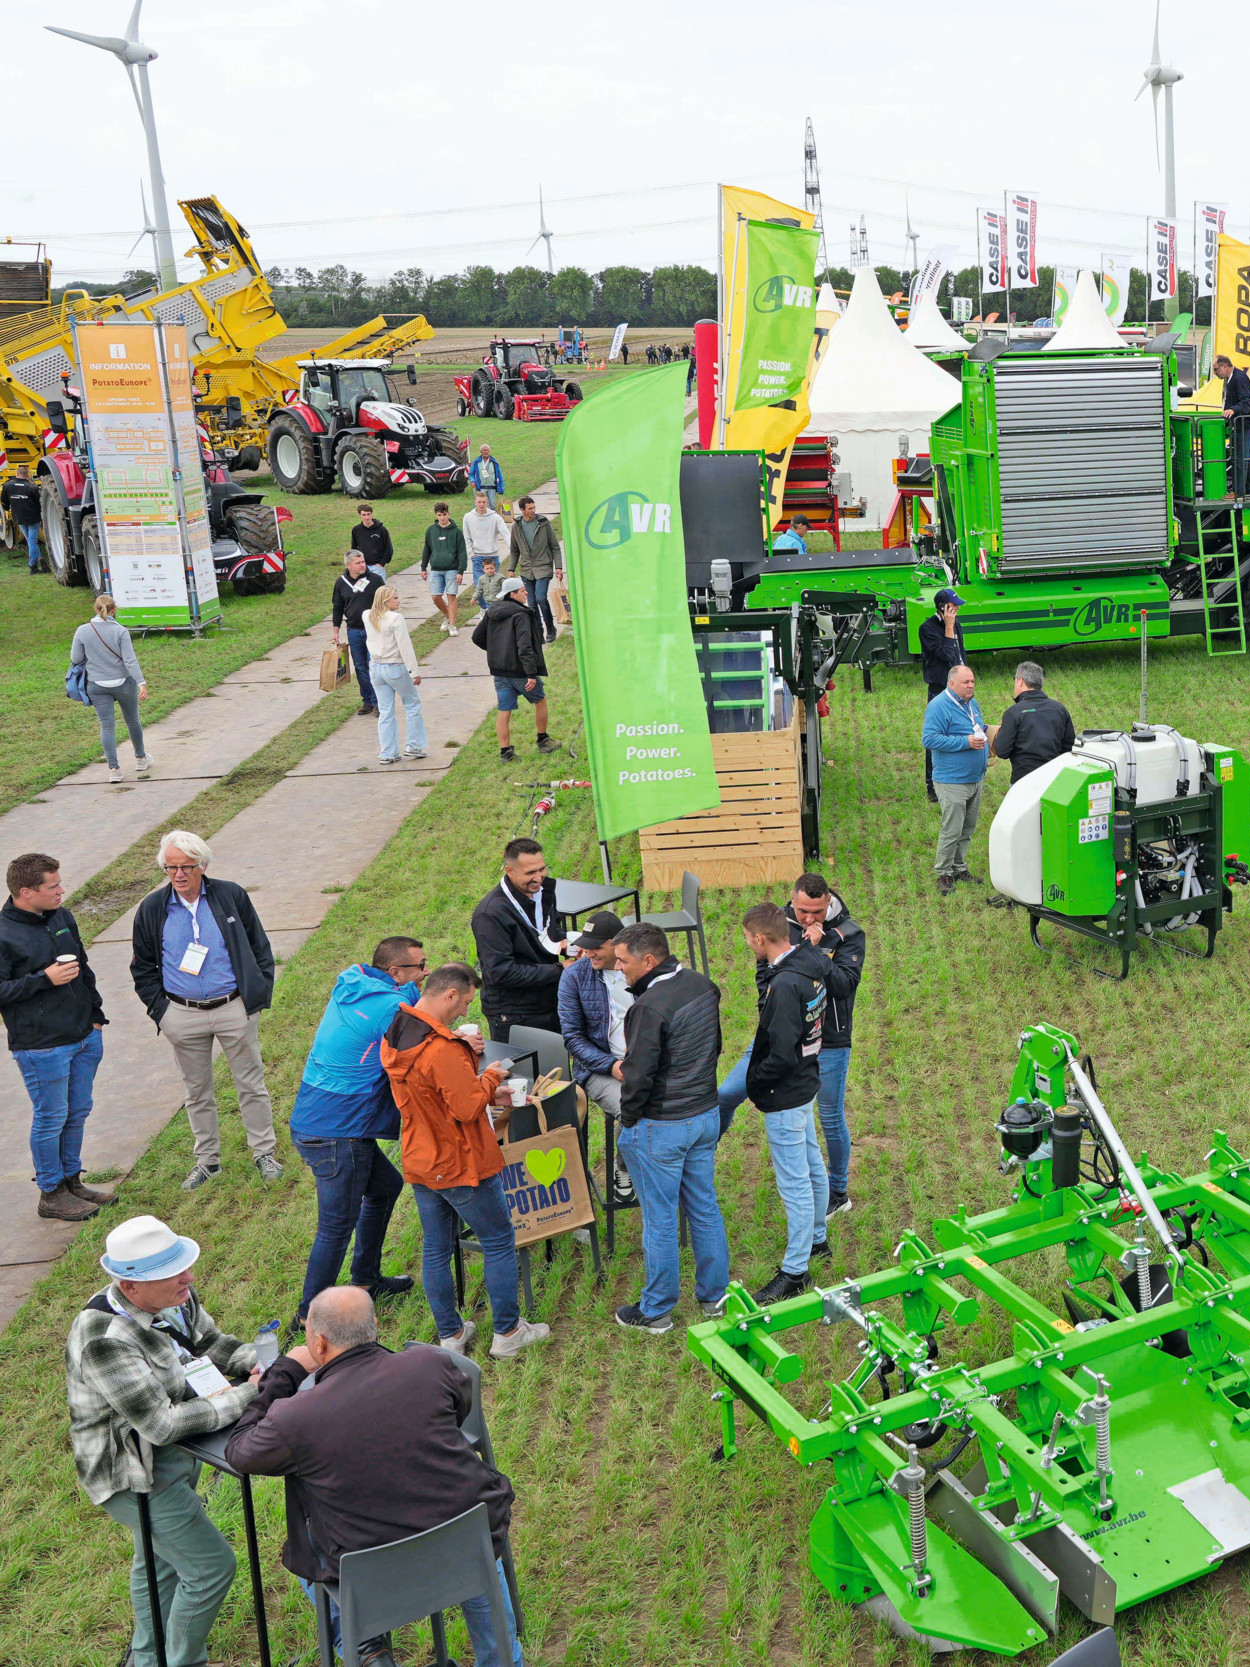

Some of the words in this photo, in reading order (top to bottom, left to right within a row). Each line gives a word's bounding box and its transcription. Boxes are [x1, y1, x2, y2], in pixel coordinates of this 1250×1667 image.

[988, 232, 999, 286] CASE
[1016, 219, 1029, 280] CASE
[1156, 241, 1169, 294] CASE
[757, 275, 813, 312] AVR
[4, 355, 19, 367] 976
[89, 362, 151, 371] INFORMATION
[758, 359, 792, 372] PASSION.
[758, 374, 786, 385] POWER.
[588, 490, 672, 542] AVR
[1077, 597, 1131, 633] AVR
[615, 720, 684, 738] Passion.
[625, 744, 682, 761] Power.
[618, 766, 696, 786] Potatoes.
[1047, 884, 1065, 902] AVR
[500, 1161, 528, 1191] WE
[504, 1177, 571, 1219] POTATO
